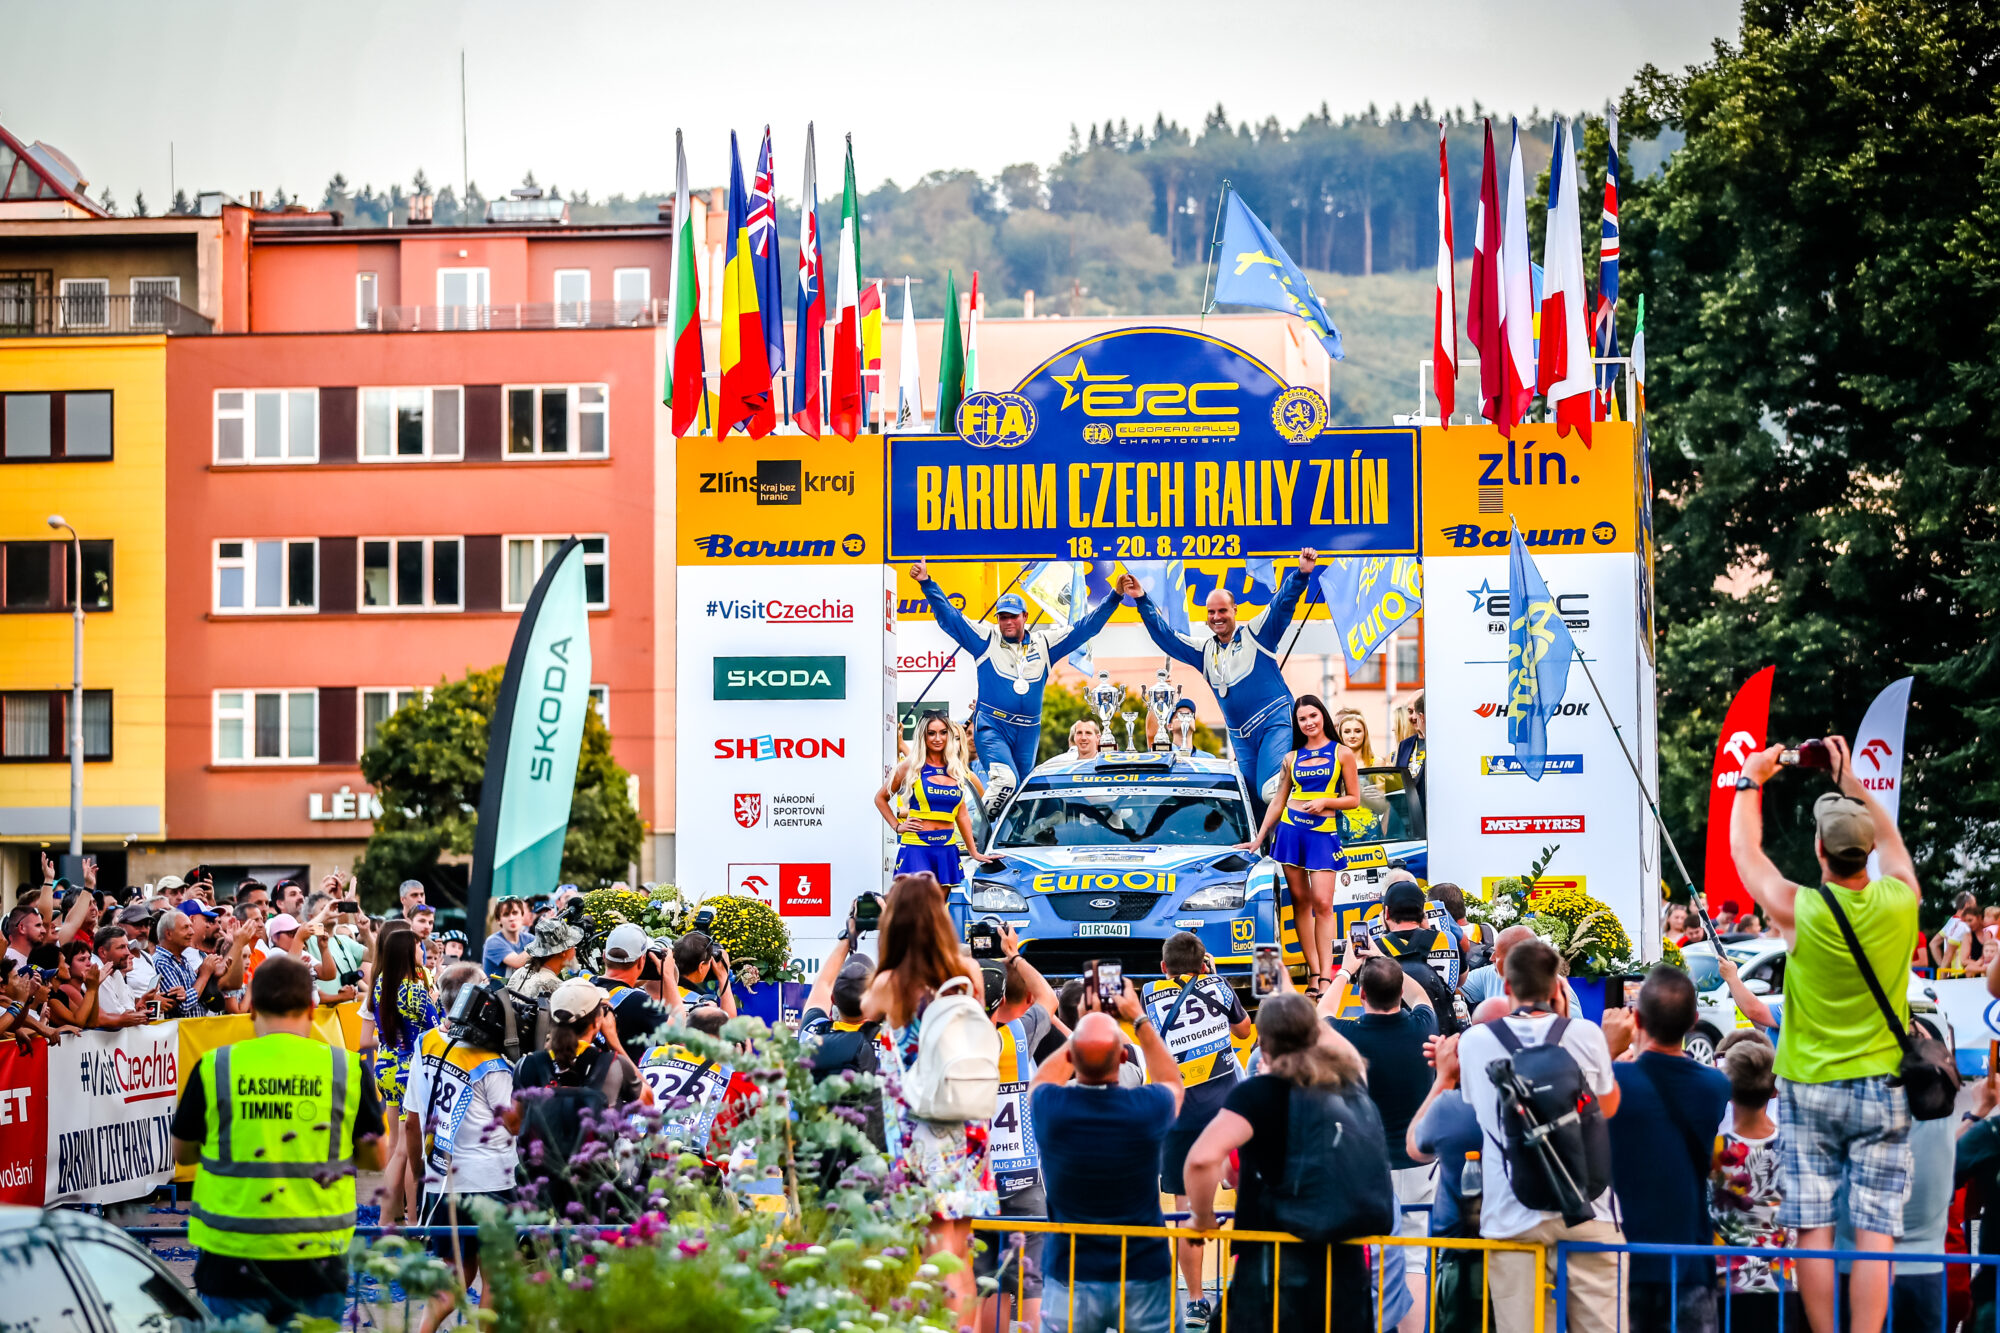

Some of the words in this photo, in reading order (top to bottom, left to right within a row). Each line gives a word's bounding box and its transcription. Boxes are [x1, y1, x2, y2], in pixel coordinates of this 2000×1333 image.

[1082, 382, 1240, 417] ERC
[1478, 440, 1580, 485] zlín.
[699, 471, 758, 493] Zlíns
[804, 471, 855, 496] kraj
[760, 483, 778, 493] Kraj
[779, 483, 796, 492] bez
[917, 463, 1057, 531] BARUM
[1069, 462, 1184, 529] CZECH
[1196, 459, 1301, 527] RALLY
[1310, 449, 1389, 526] ZLÍN
[760, 492, 788, 501] hranic
[694, 534, 836, 558] Barum
[1066, 537, 1098, 558] 18.
[1117, 537, 1152, 558] 20.
[1157, 536, 1178, 557] 8.
[1183, 535, 1241, 557] 2023
[705, 599, 855, 621] #VisitCzechia
[714, 734, 846, 762] SHERON
[1072, 774, 1139, 783] EuroOil
[1295, 768, 1330, 778] EuroOil
[773, 793, 816, 804] NÁRODNÍ
[927, 786, 961, 797] EuroOil
[773, 804, 826, 816] SPORTOVNÍ
[773, 817, 823, 827] AGENTURA
[1485, 819, 1532, 831] MRF
[1533, 818, 1581, 831] TYRES
[1032, 871, 1177, 893] EuroOil
[1081, 924, 1101, 935] 01R
[1106, 924, 1129, 936] 0401
[1170, 1021, 1228, 1048] PHOTOGRAPHER
[238, 1074, 323, 1098] ČASOMĚŘIČ
[0, 1086, 32, 1126] ET
[241, 1100, 293, 1120] TIMING
[1011, 1158, 1031, 1168] 2023
